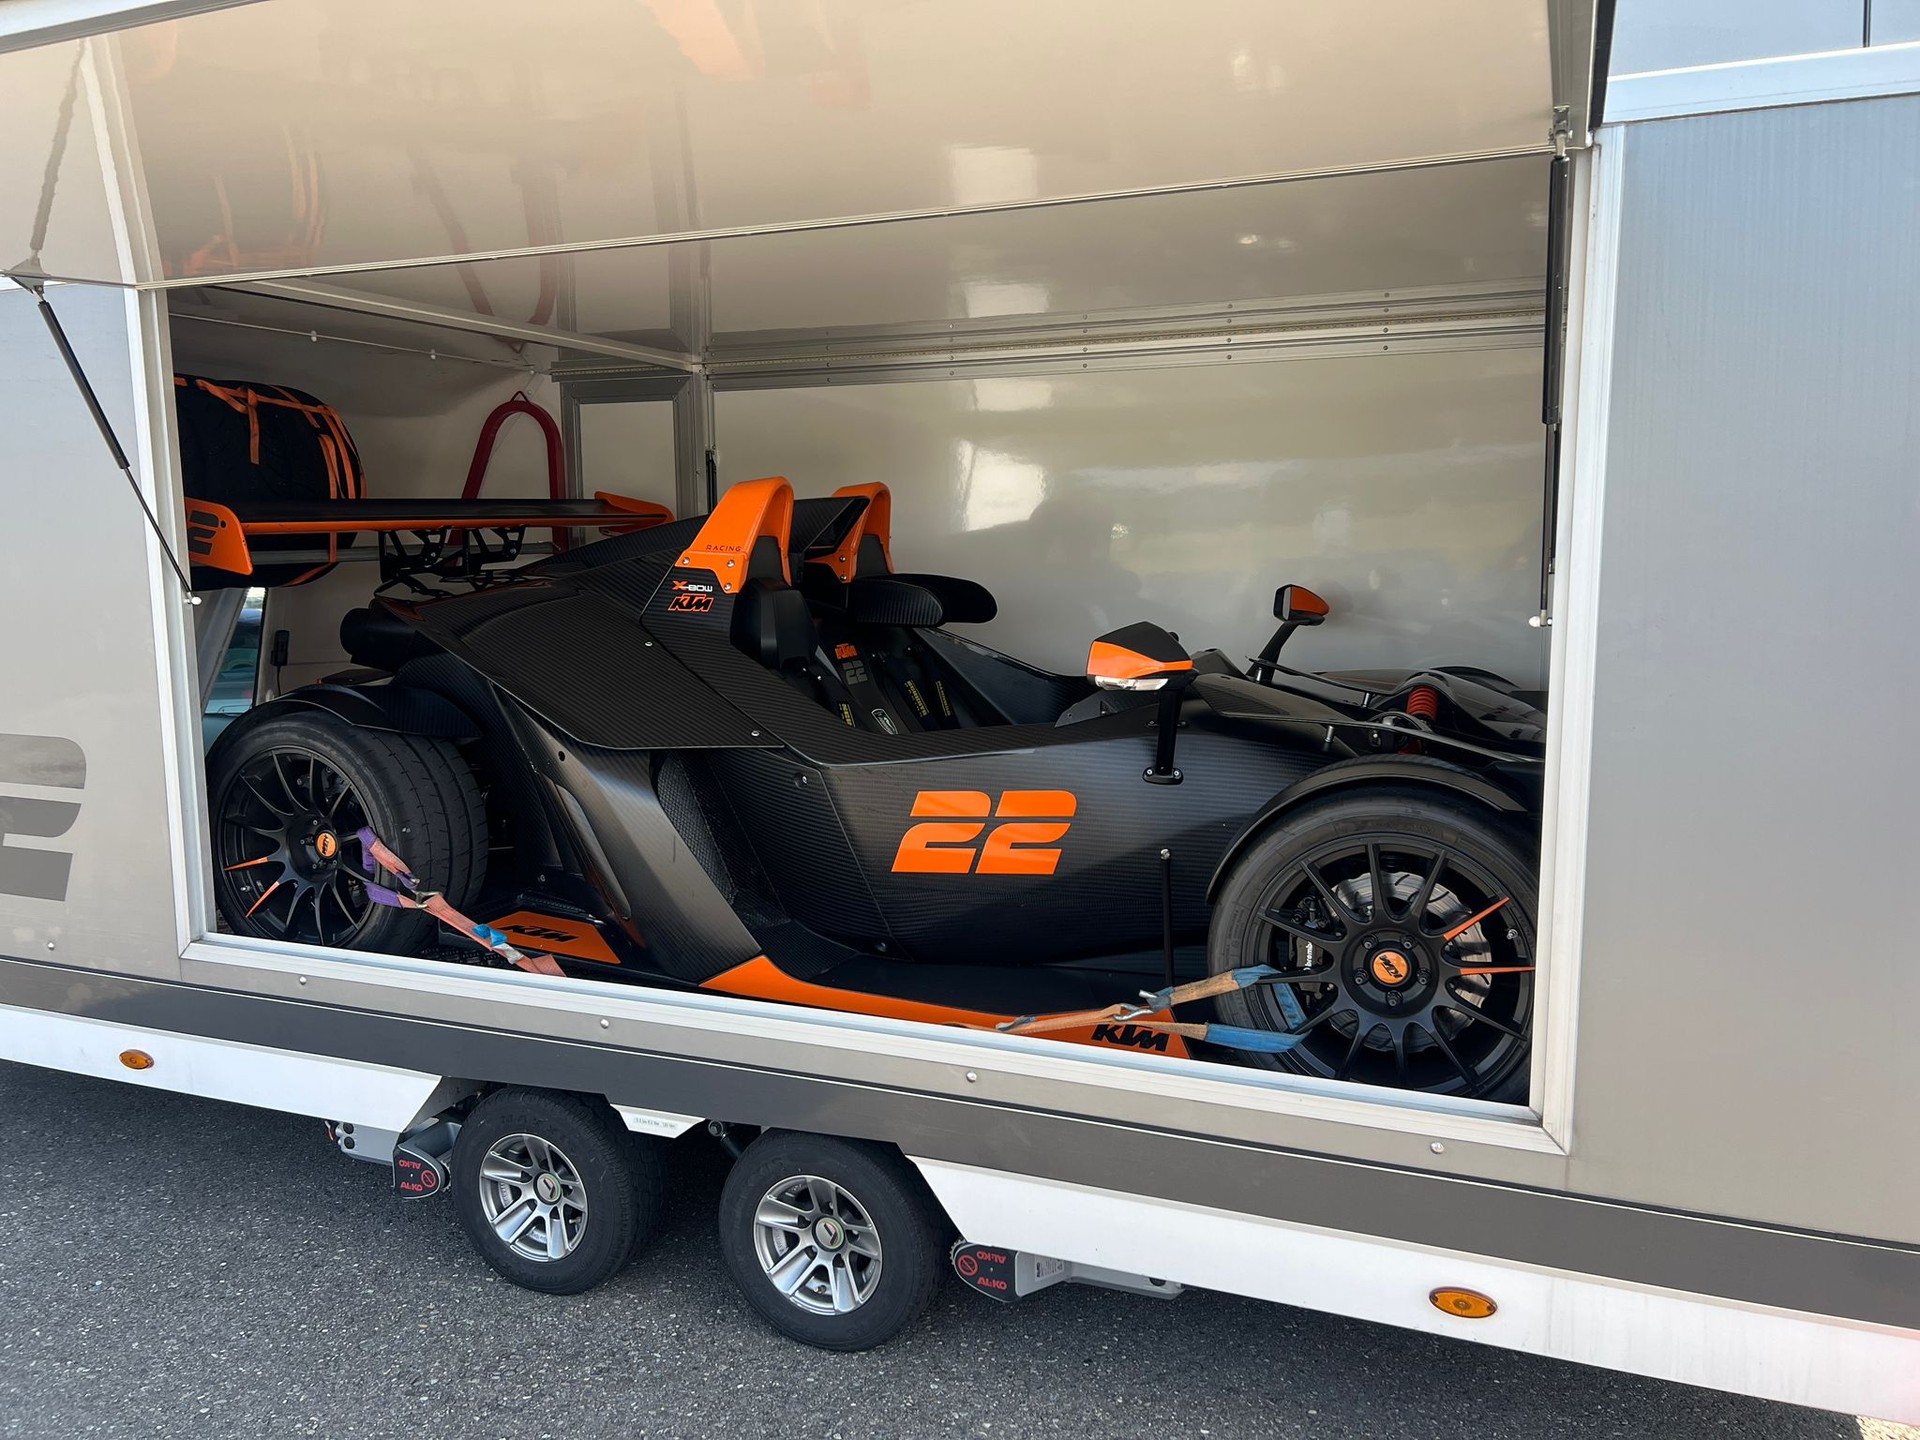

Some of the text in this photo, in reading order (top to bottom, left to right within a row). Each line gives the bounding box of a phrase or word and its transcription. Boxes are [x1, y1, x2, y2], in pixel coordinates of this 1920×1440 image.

[705, 544, 742, 552] RACING
[668, 593, 714, 612] KTM
[891, 790, 1077, 875] 22
[1091, 1023, 1170, 1052] KTM
